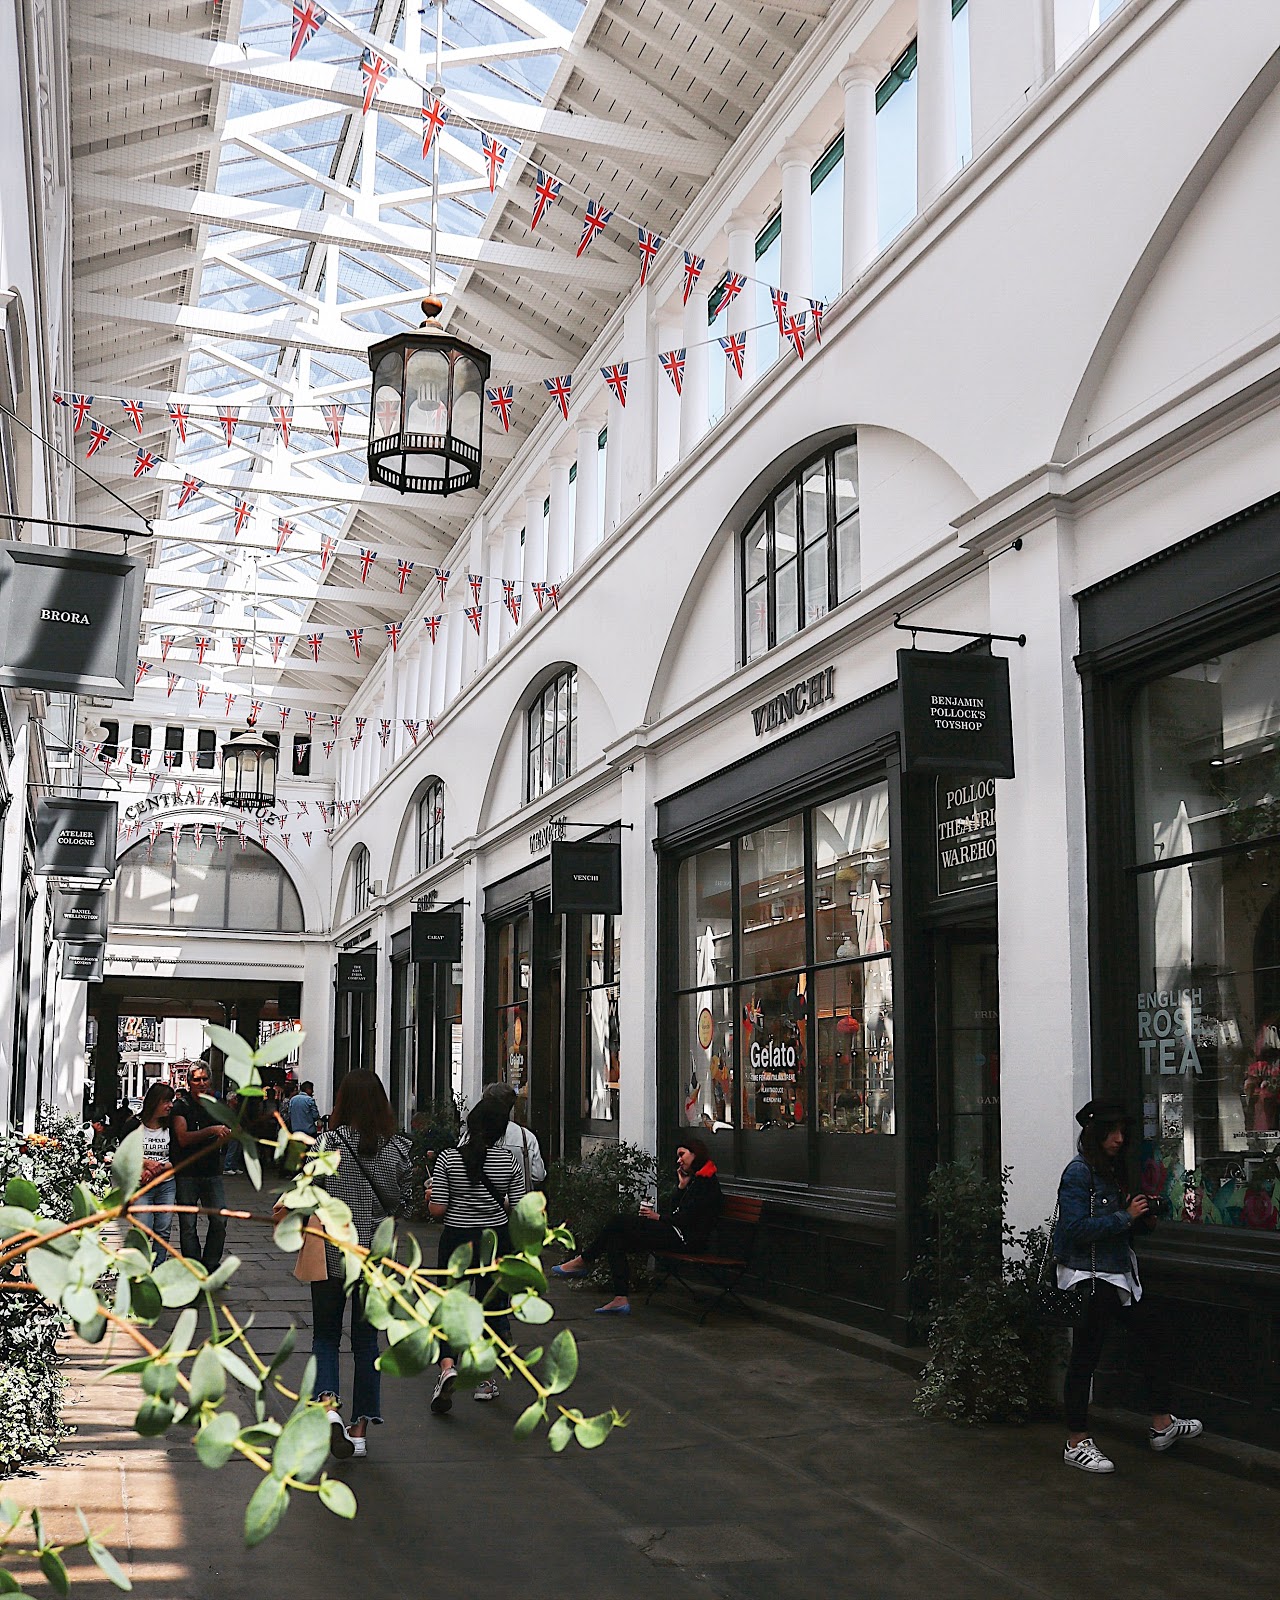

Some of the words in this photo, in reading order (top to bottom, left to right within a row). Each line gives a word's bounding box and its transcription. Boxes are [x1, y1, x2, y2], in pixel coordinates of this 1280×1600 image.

[40, 608, 91, 625] BRORA
[751, 665, 834, 737] VENCHI
[930, 695, 984, 707] BENJAMIN
[930, 707, 986, 719] POLLOCK'S
[934, 719, 983, 731] TOYSHOP
[124, 790, 206, 820] CENTRAL
[946, 778, 996, 810] POLLOC
[60, 830, 93, 838] ATELIER
[939, 808, 996, 840] THEATRI
[58, 837, 95, 846] COLOGNE
[941, 838, 997, 868] WAREHO
[1137, 987, 1202, 1010] ENGLISH
[974, 1010, 998, 1019] PRIN
[1138, 1007, 1203, 1038] ROSE
[750, 1040, 796, 1068] Gelato
[1138, 1035, 1203, 1075] TEA
[977, 1096, 999, 1105] GAM
